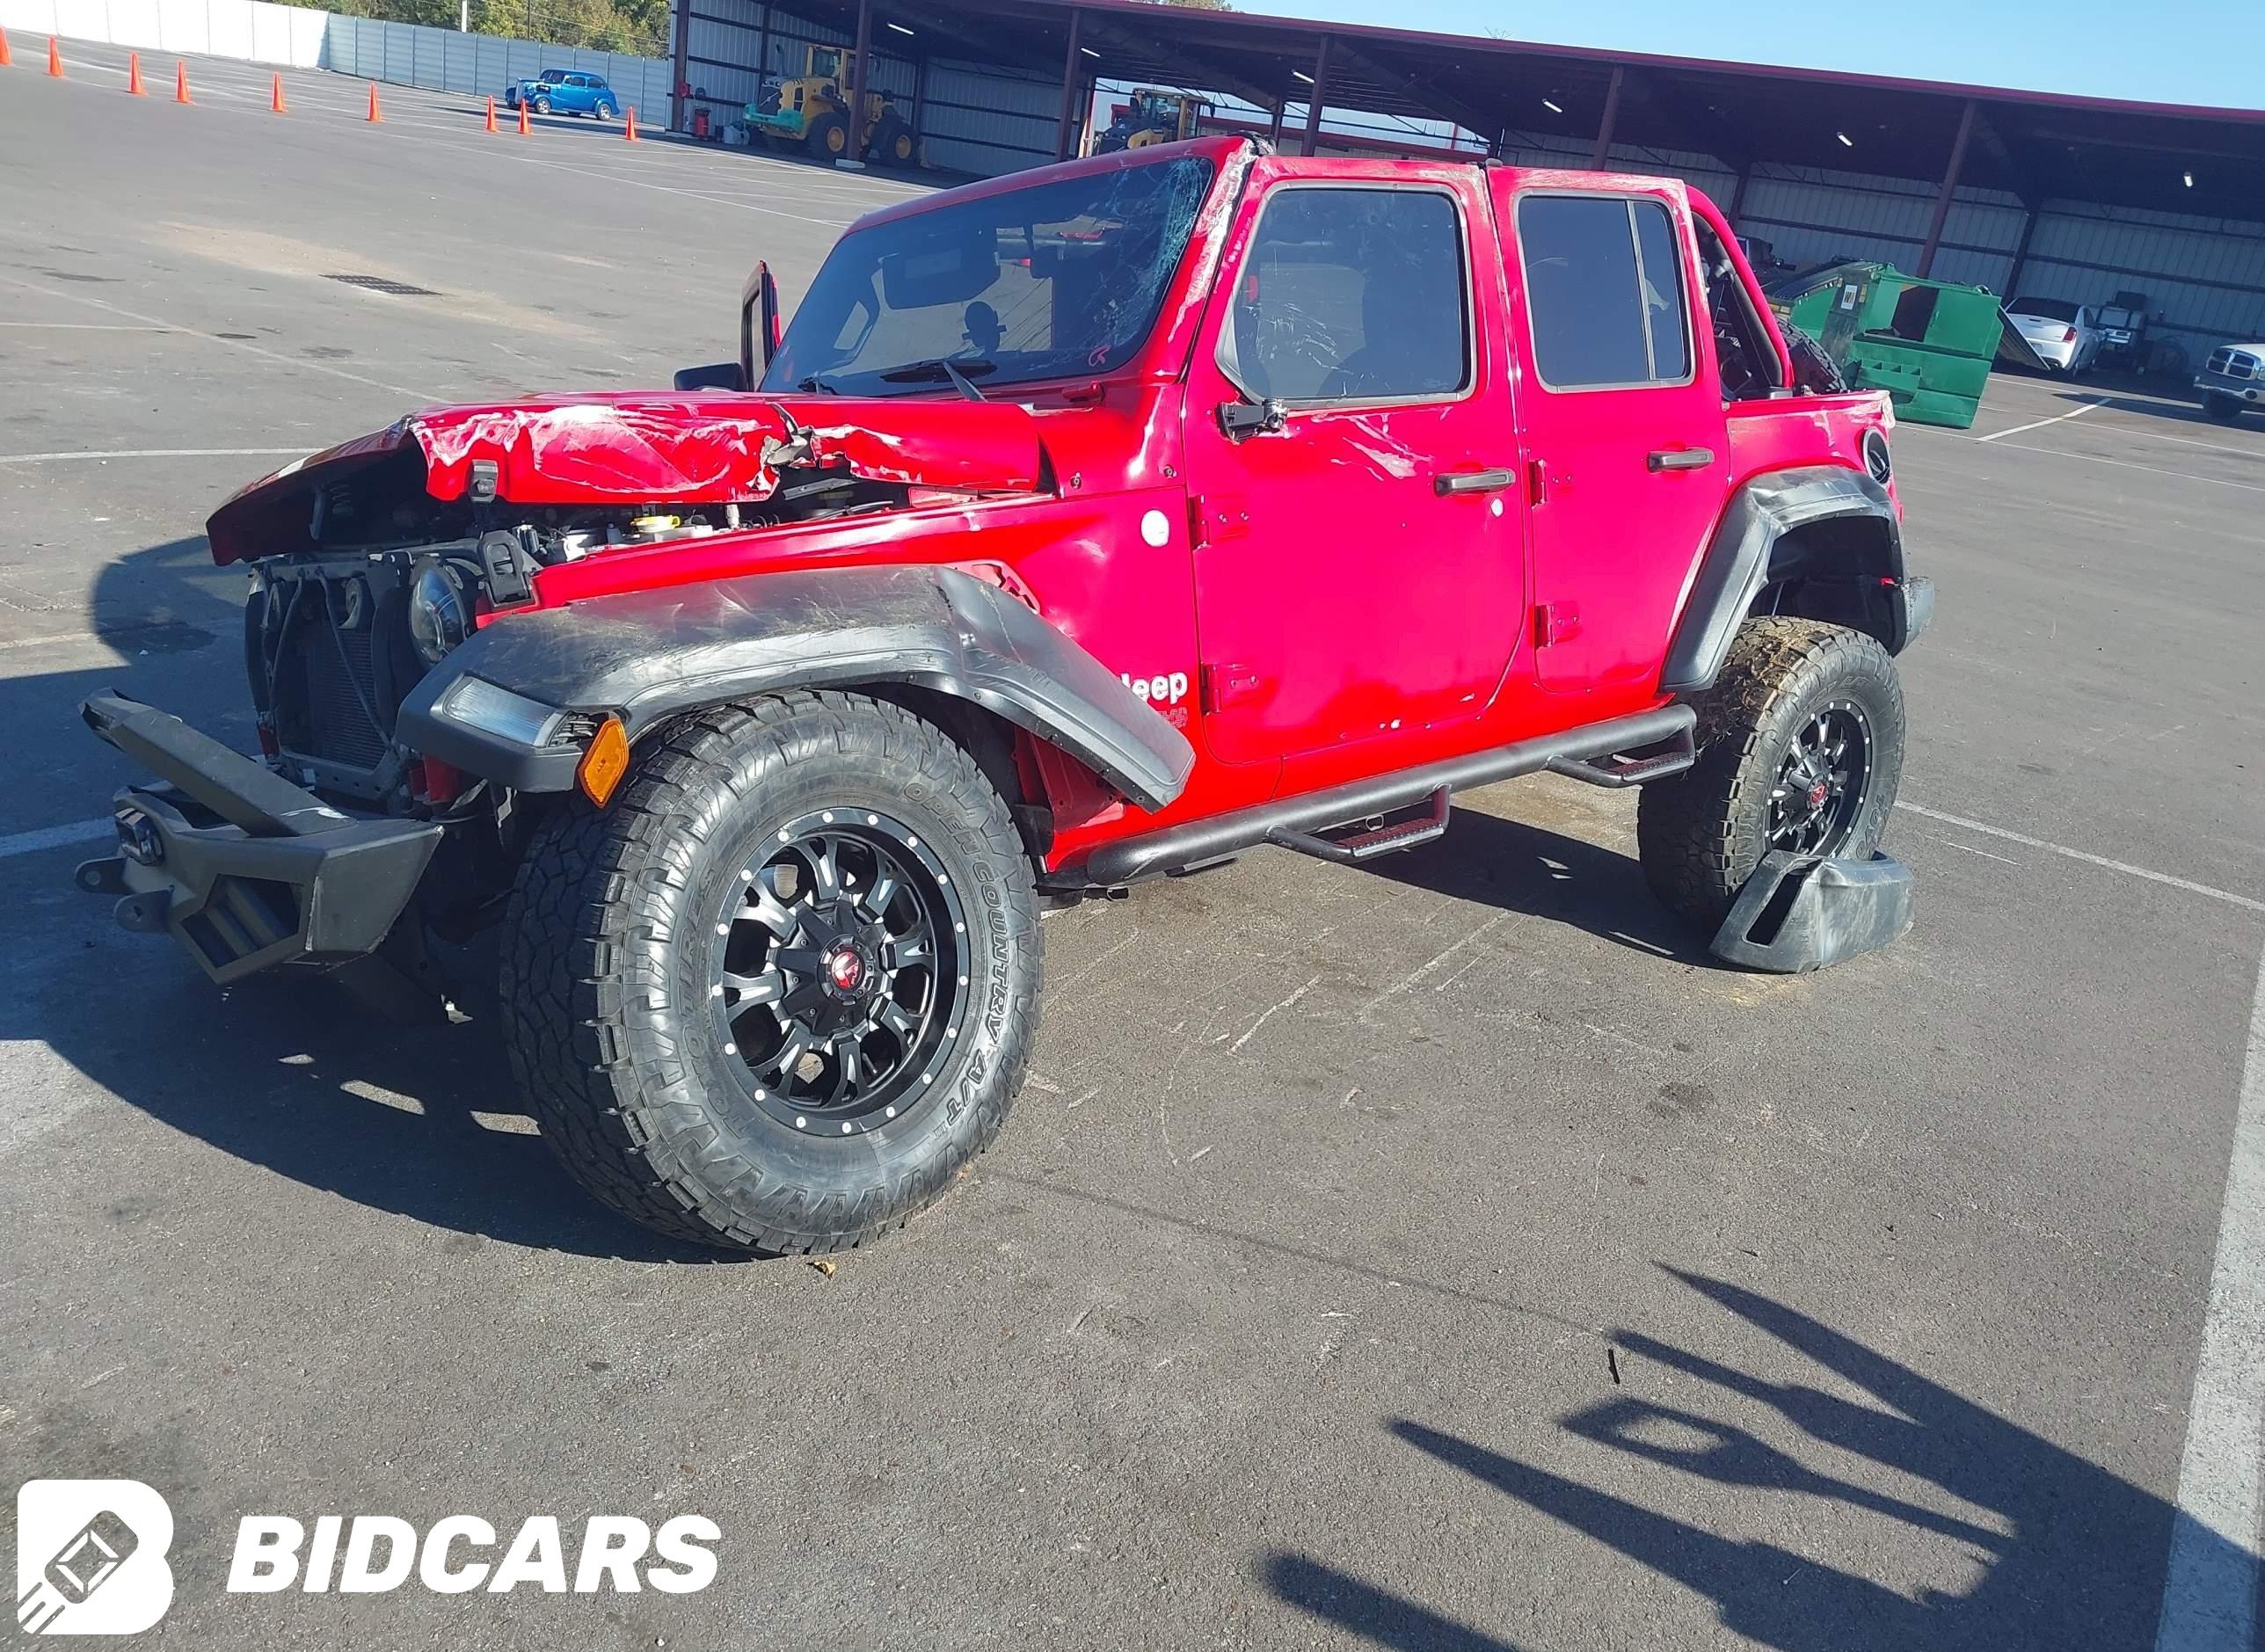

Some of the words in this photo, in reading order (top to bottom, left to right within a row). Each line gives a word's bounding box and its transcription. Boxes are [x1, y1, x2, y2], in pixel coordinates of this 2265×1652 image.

[903, 782, 981, 856] OPEN
[972, 861, 1009, 1044] COUNTRY
[947, 1047, 987, 1127] A/T
